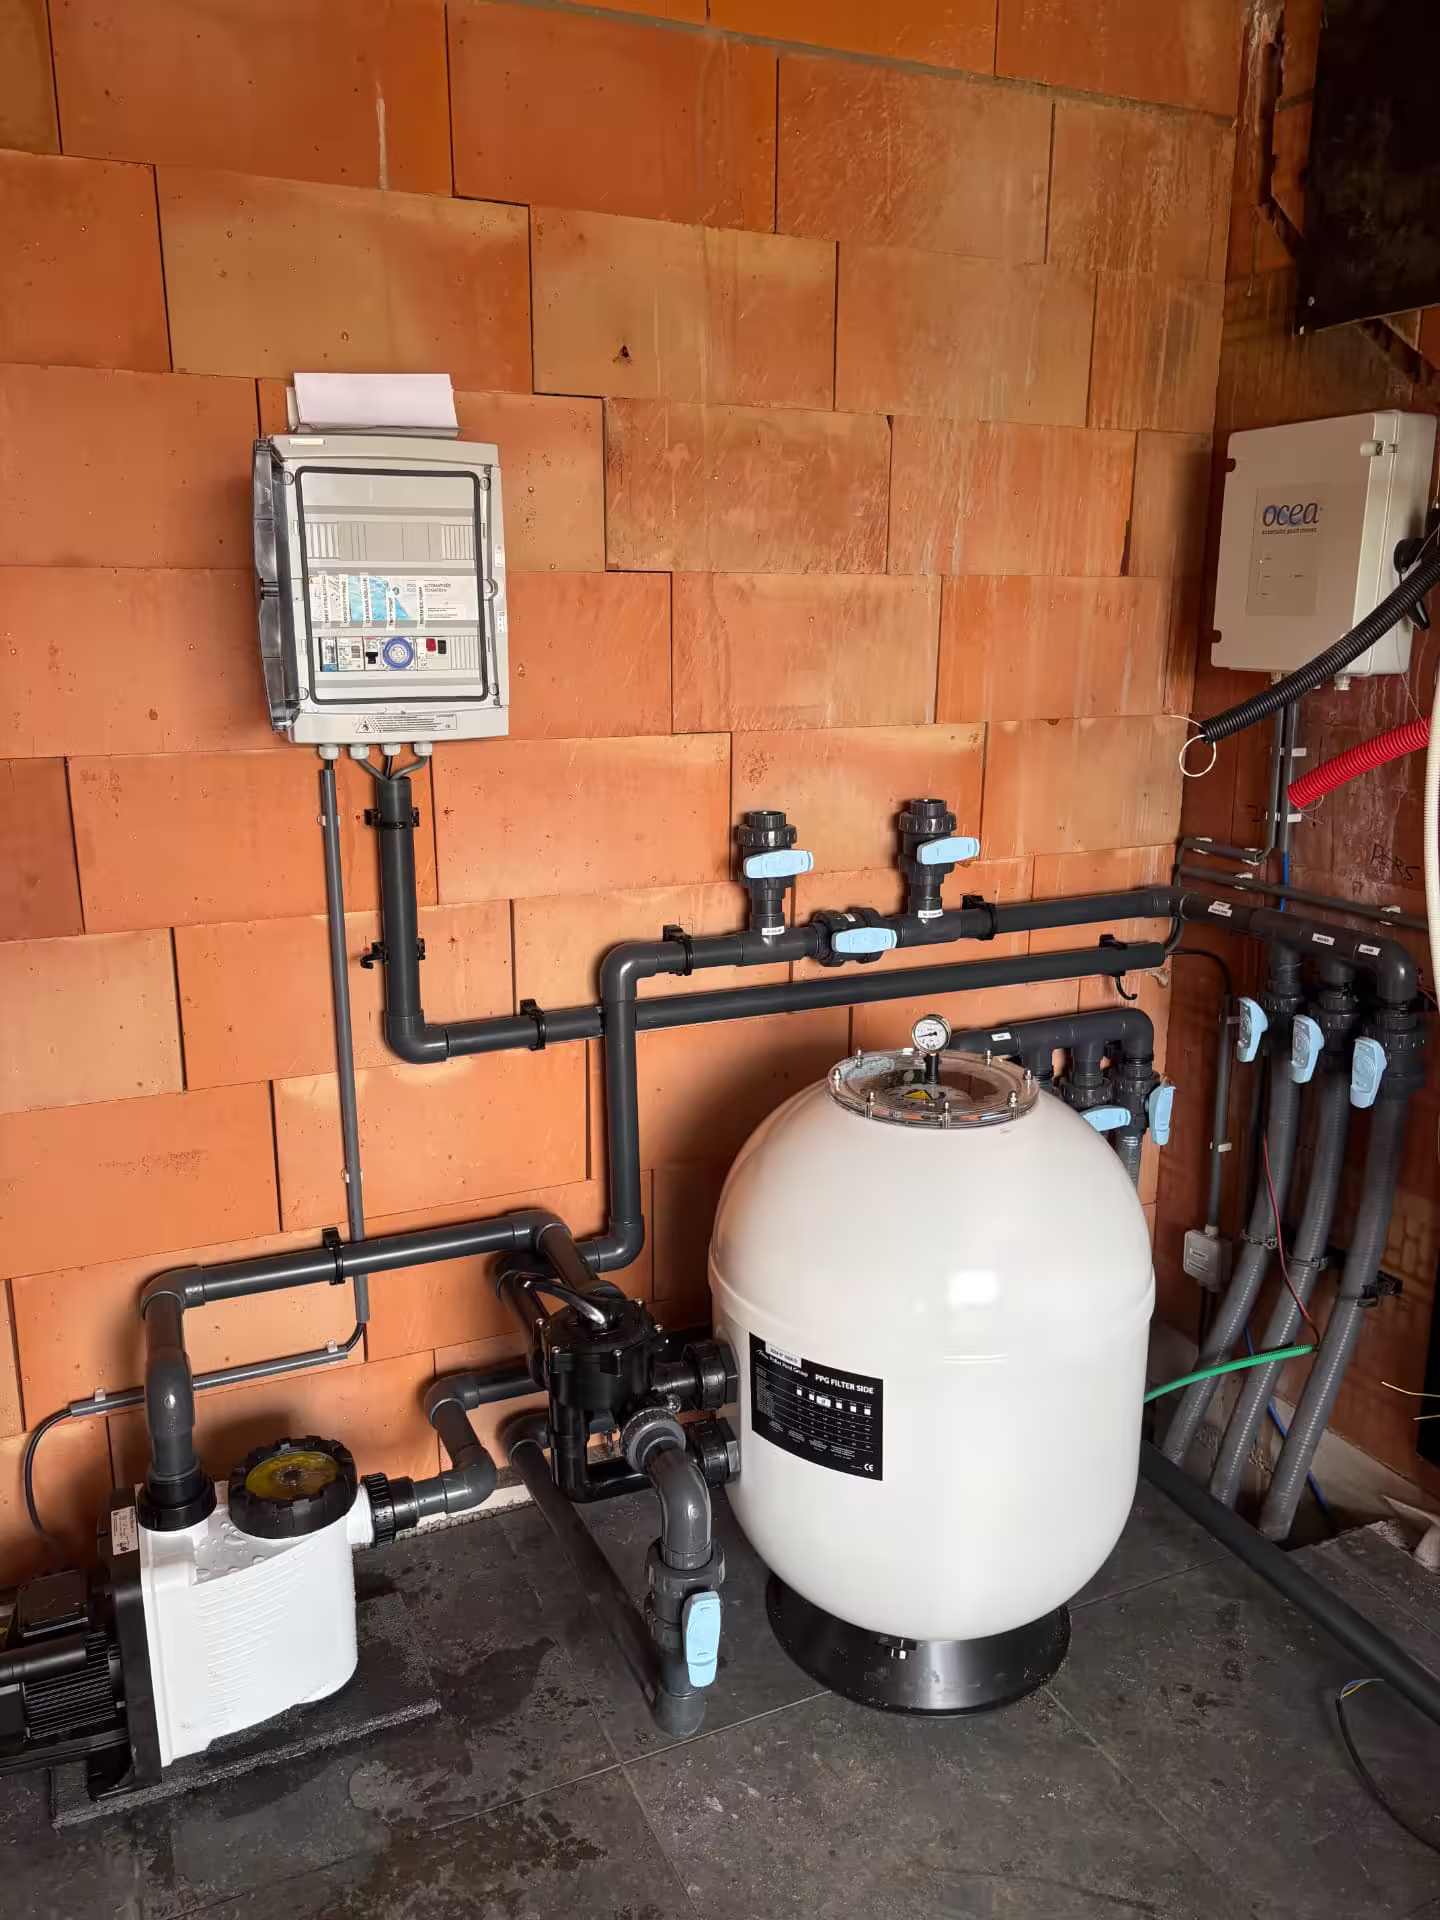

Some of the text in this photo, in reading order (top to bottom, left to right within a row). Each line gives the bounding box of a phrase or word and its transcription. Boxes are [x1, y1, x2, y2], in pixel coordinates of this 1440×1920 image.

[1262, 502, 1319, 527] ocea
[815, 1373, 874, 1394] PPG FILTER SIDE
